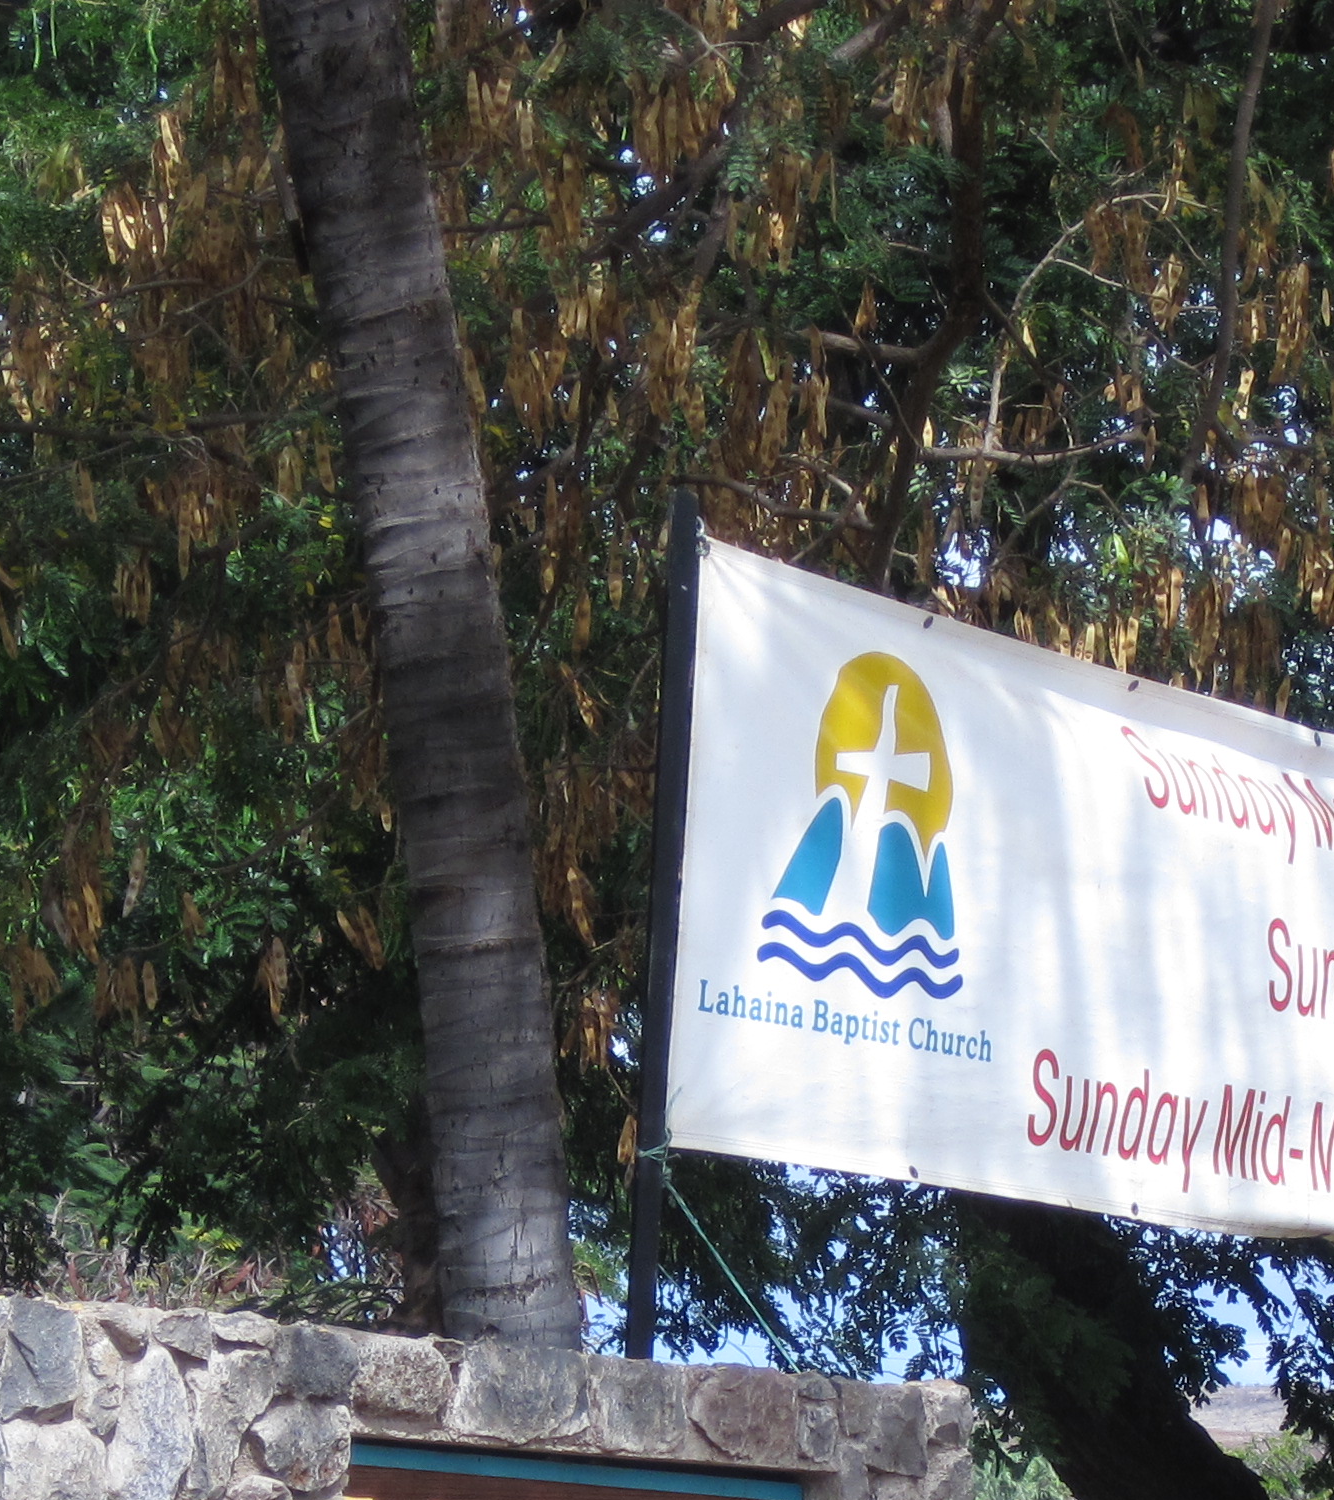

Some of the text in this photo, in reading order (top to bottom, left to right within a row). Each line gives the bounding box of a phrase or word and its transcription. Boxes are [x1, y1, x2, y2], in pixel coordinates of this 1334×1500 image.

[1120, 725, 1297, 865] Sunday
[697, 979, 993, 1063] Lahaina Baptist Church
[1027, 1048, 1209, 1194] Sunday
